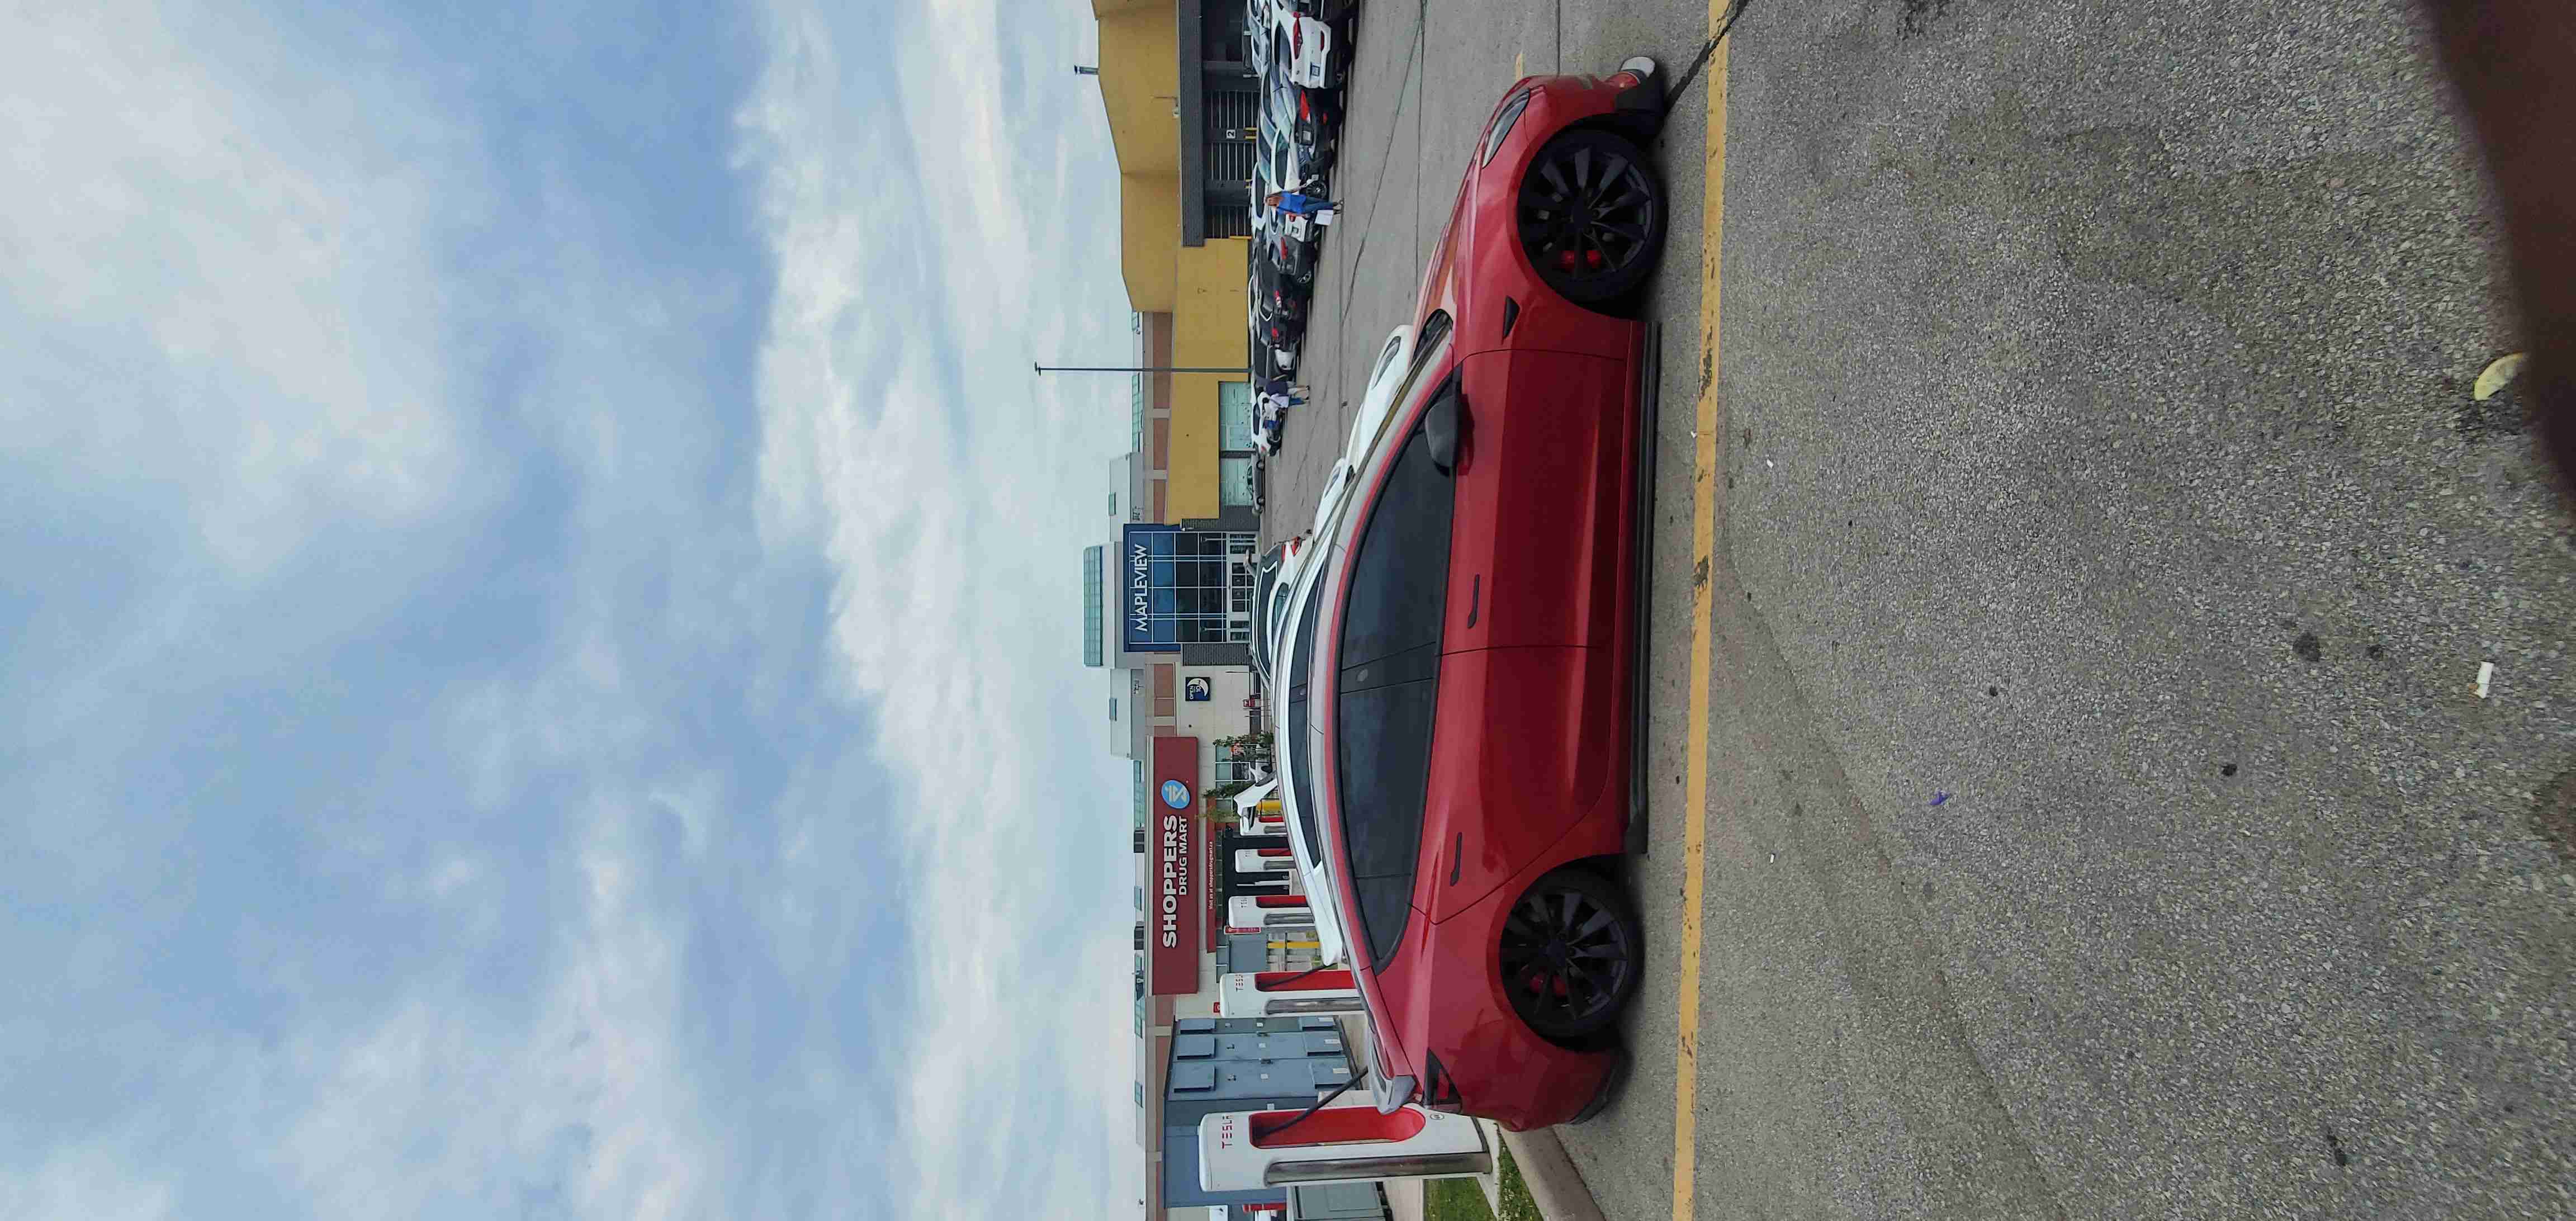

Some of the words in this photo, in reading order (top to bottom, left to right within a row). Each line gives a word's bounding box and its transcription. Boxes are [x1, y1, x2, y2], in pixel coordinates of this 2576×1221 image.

[1134, 543, 1147, 632] MAPLEVIEW
[1179, 816, 1187, 854] MART
[1163, 815, 1177, 948] SHOPPERS
[1179, 856, 1187, 895] DRUG
[1221, 1115, 1232, 1149] TESLA
